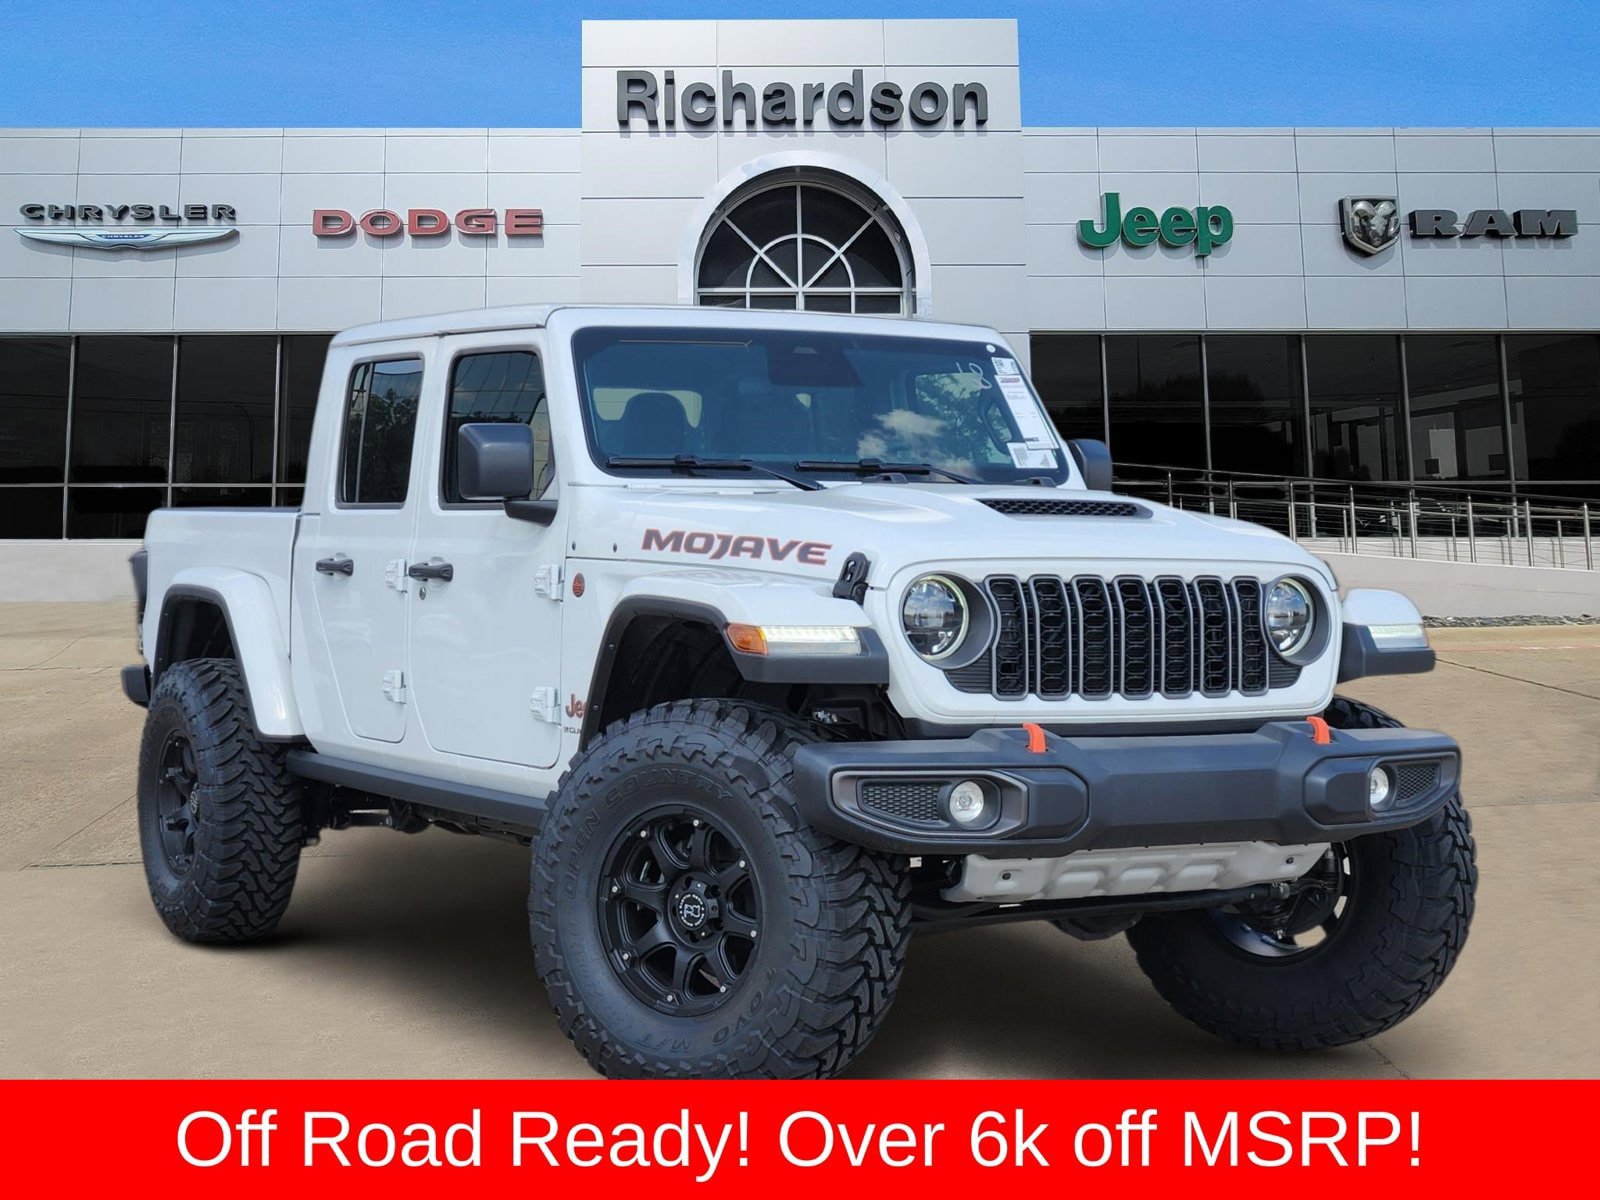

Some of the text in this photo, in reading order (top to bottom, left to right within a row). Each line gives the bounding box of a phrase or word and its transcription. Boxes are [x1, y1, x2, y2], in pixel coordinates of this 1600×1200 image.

[616, 69, 989, 126] Richardson
[19, 203, 237, 221] CHRYSLER
[312, 208, 544, 238] DODGE
[1077, 192, 1234, 257] Jeep
[1408, 209, 1578, 239] RAM
[641, 528, 833, 566] MOJAVE
[604, 767, 734, 810] COUNTRY
